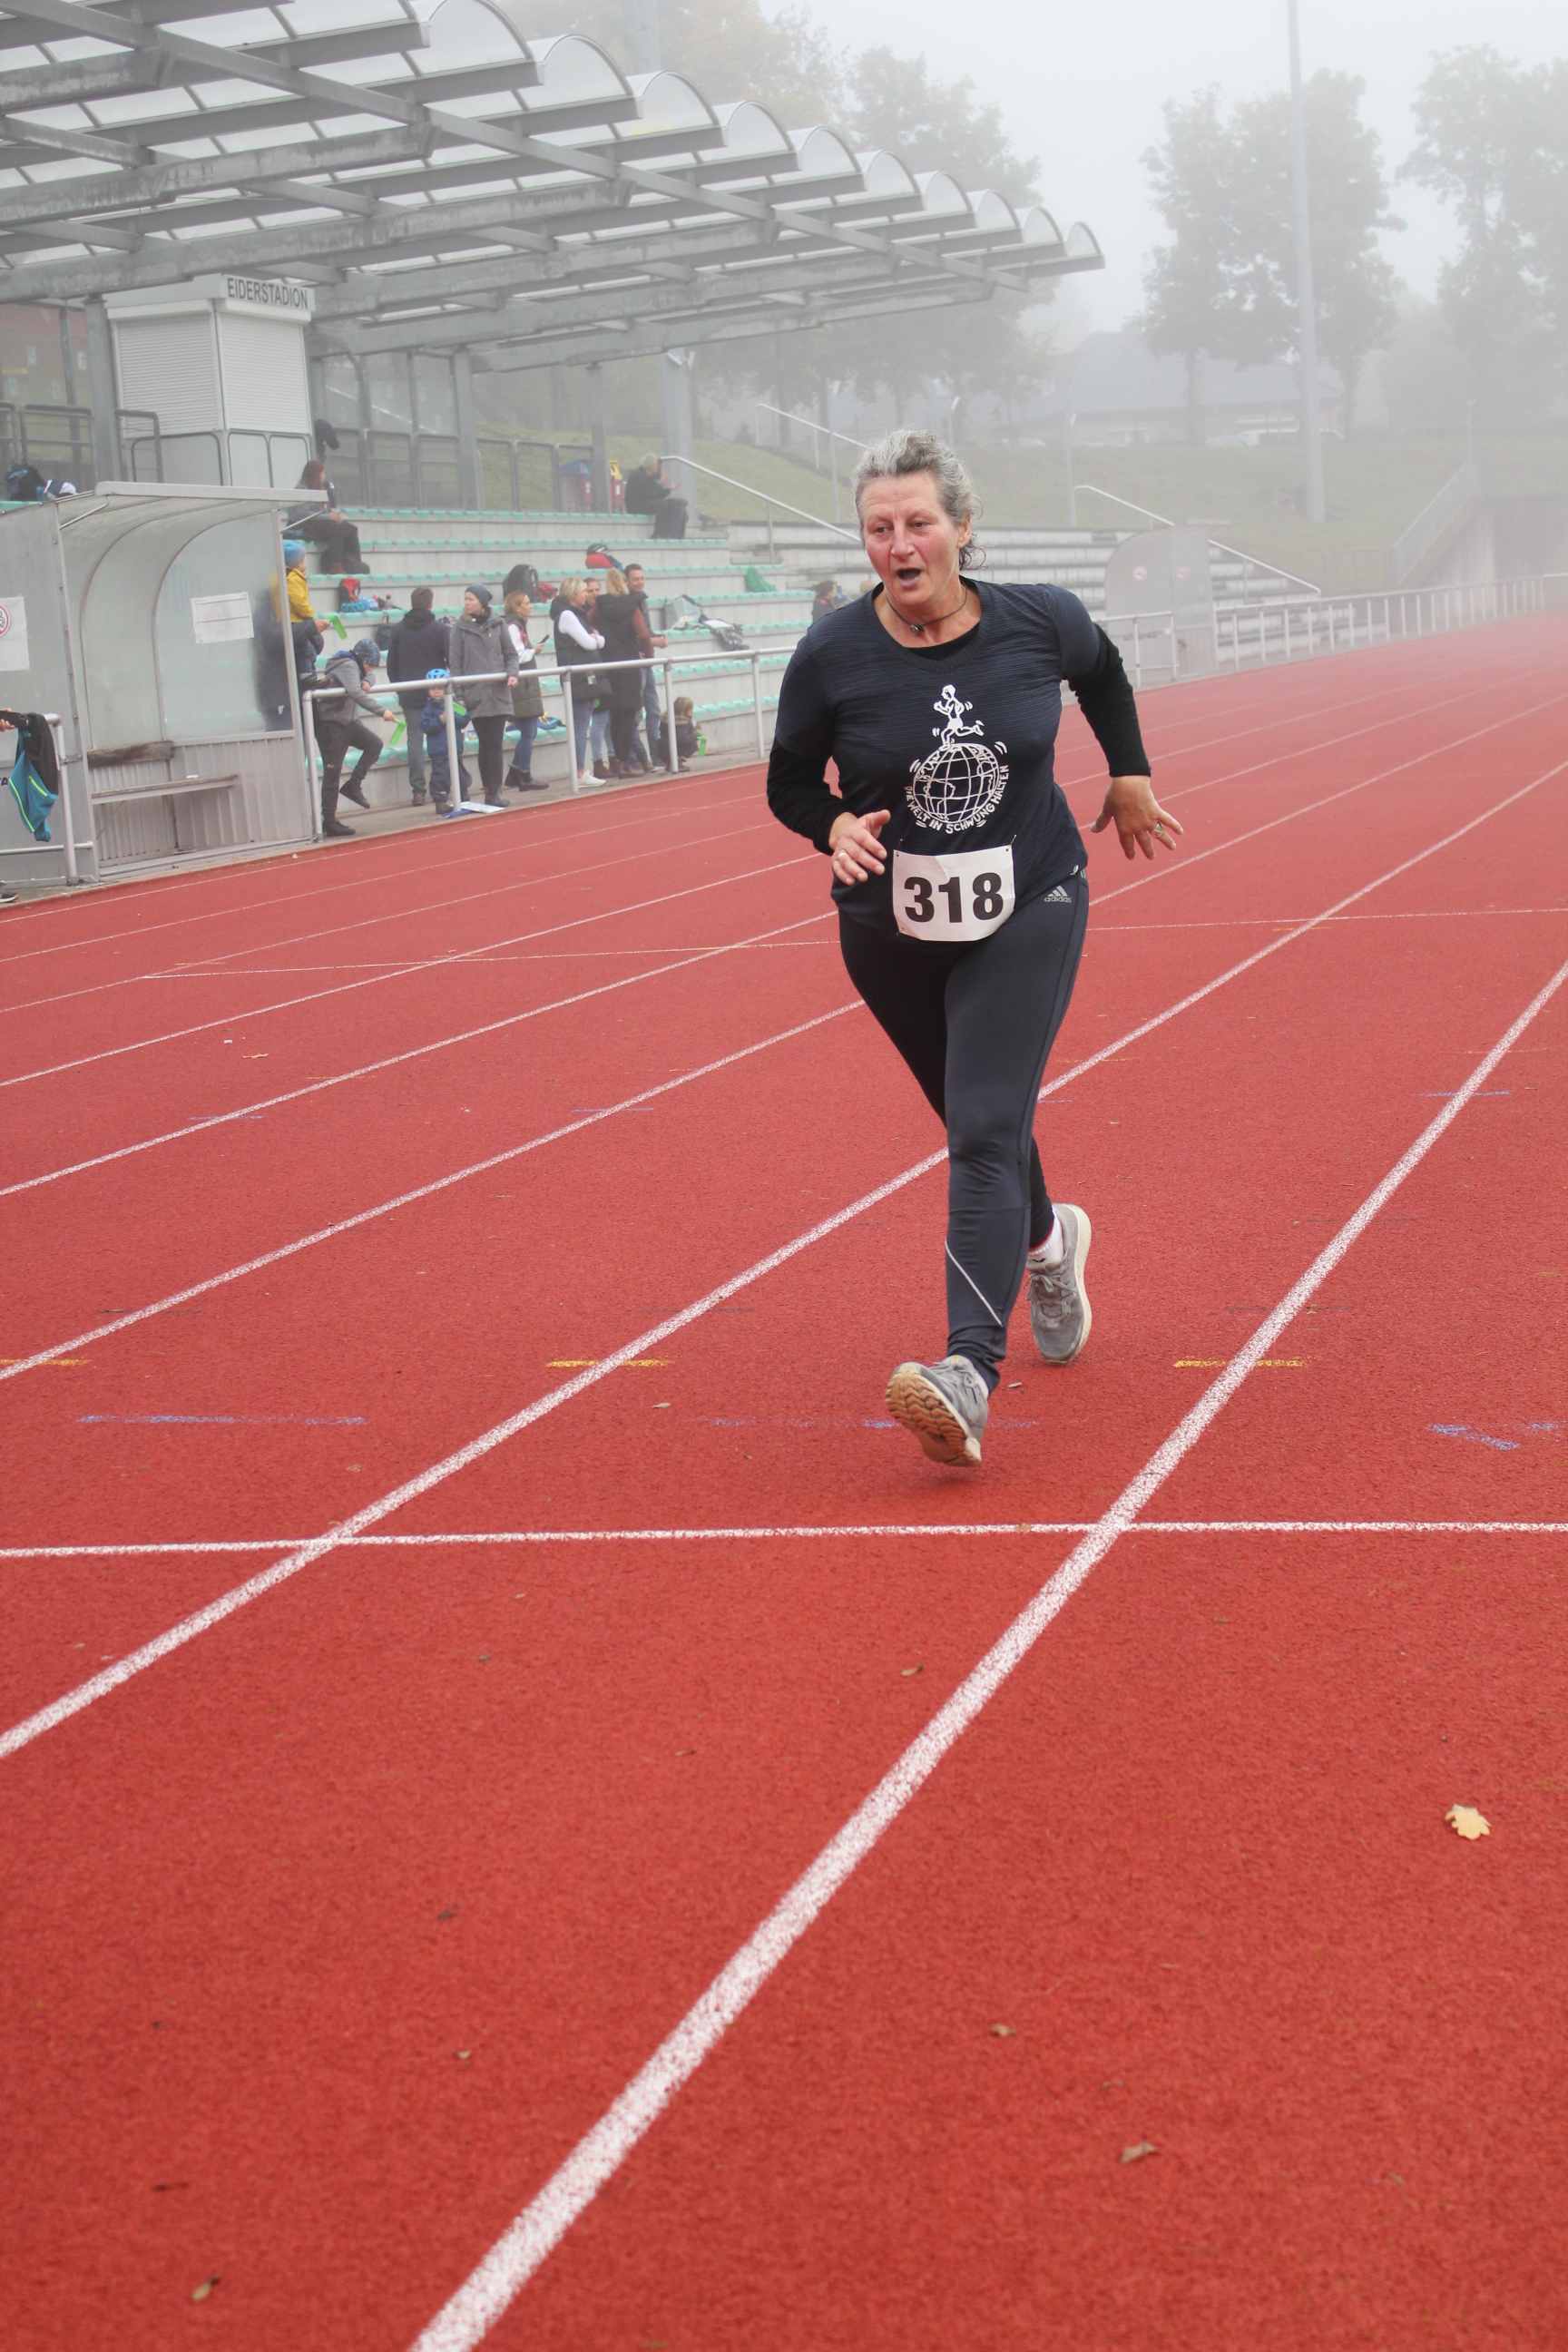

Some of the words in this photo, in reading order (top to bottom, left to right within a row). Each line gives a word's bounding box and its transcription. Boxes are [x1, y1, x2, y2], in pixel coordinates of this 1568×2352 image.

[227, 277, 309, 309] EIDERSTADION
[907, 800, 931, 822] WELT
[928, 818, 944, 831] IN
[945, 802, 995, 834] SCHWUNG
[990, 764, 1010, 805] HALTEN
[904, 872, 1004, 924] 318
